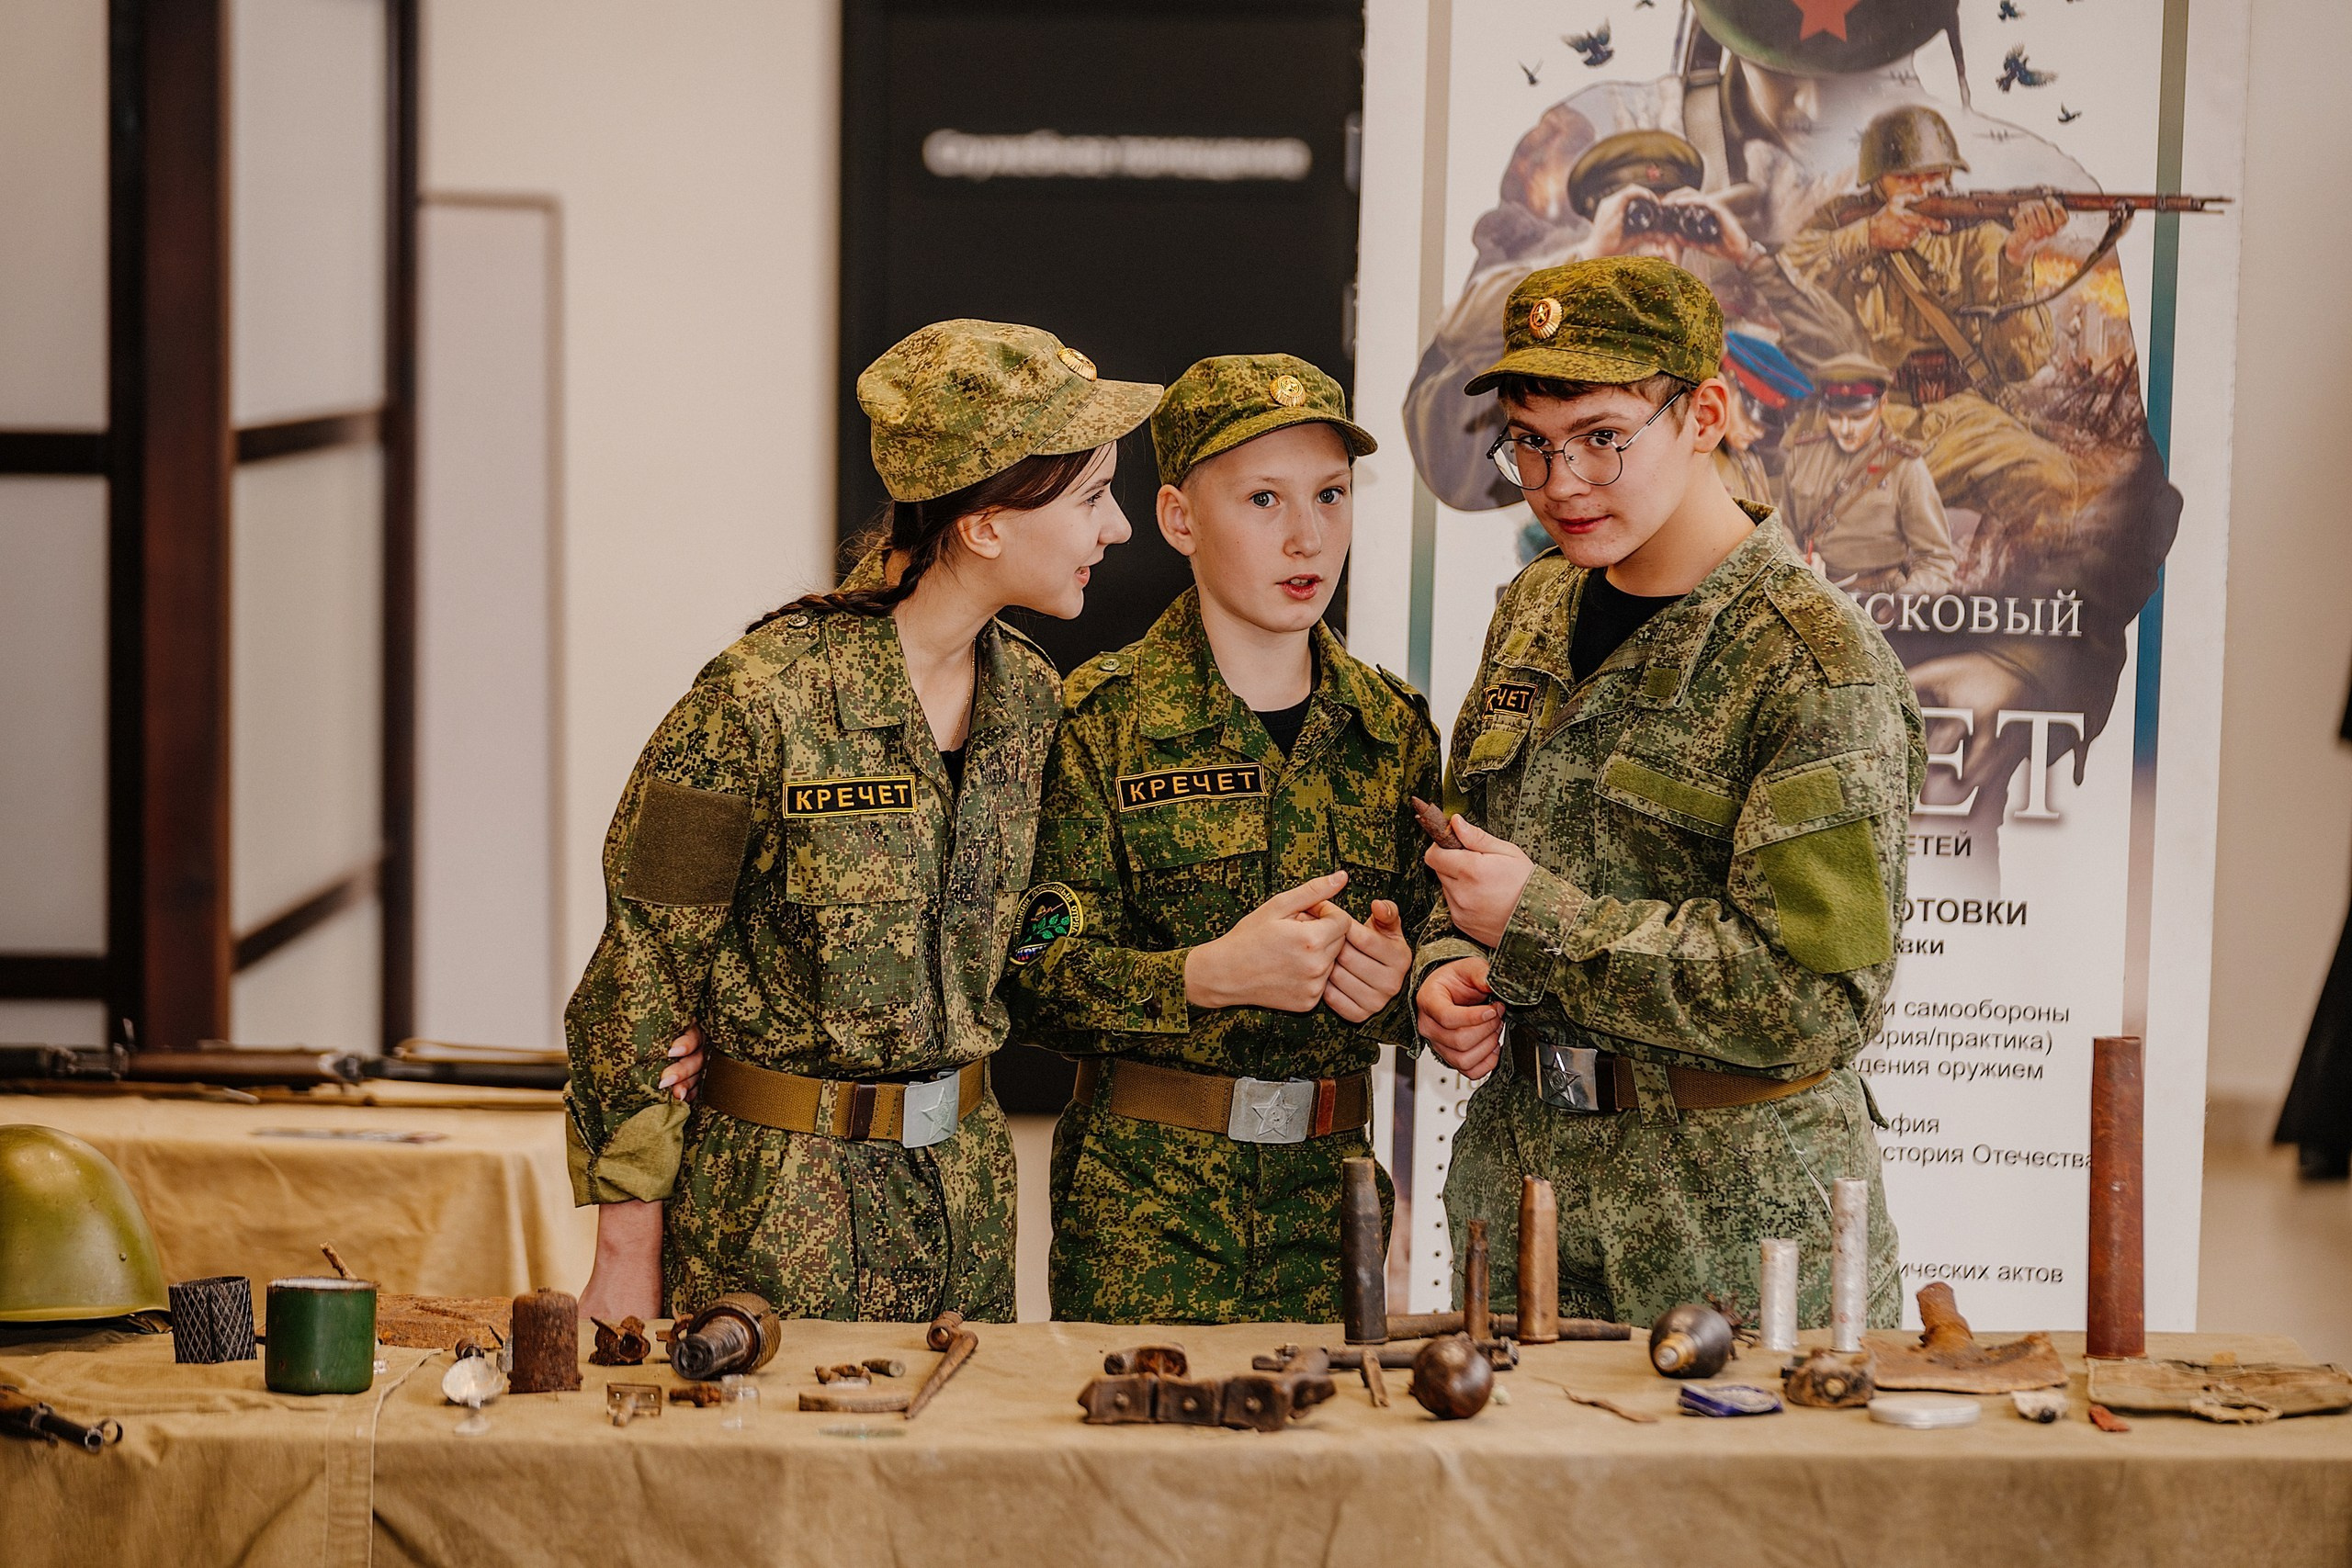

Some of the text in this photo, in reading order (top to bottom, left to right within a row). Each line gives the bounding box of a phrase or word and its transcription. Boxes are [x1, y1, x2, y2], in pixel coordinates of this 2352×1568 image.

[1848, 589, 2084, 637] СКОВЫЙ
[796, 784, 909, 810] КРЕЧЕТ
[1130, 772, 1255, 802] КРЕЧЕТ
[1904, 998, 2070, 1024] самообороны
[1852, 1057, 2044, 1082] дения оружием
[1871, 1112, 1939, 1137] фия
[1879, 1145, 1963, 1168] стория
[1997, 1264, 2064, 1283] актов
